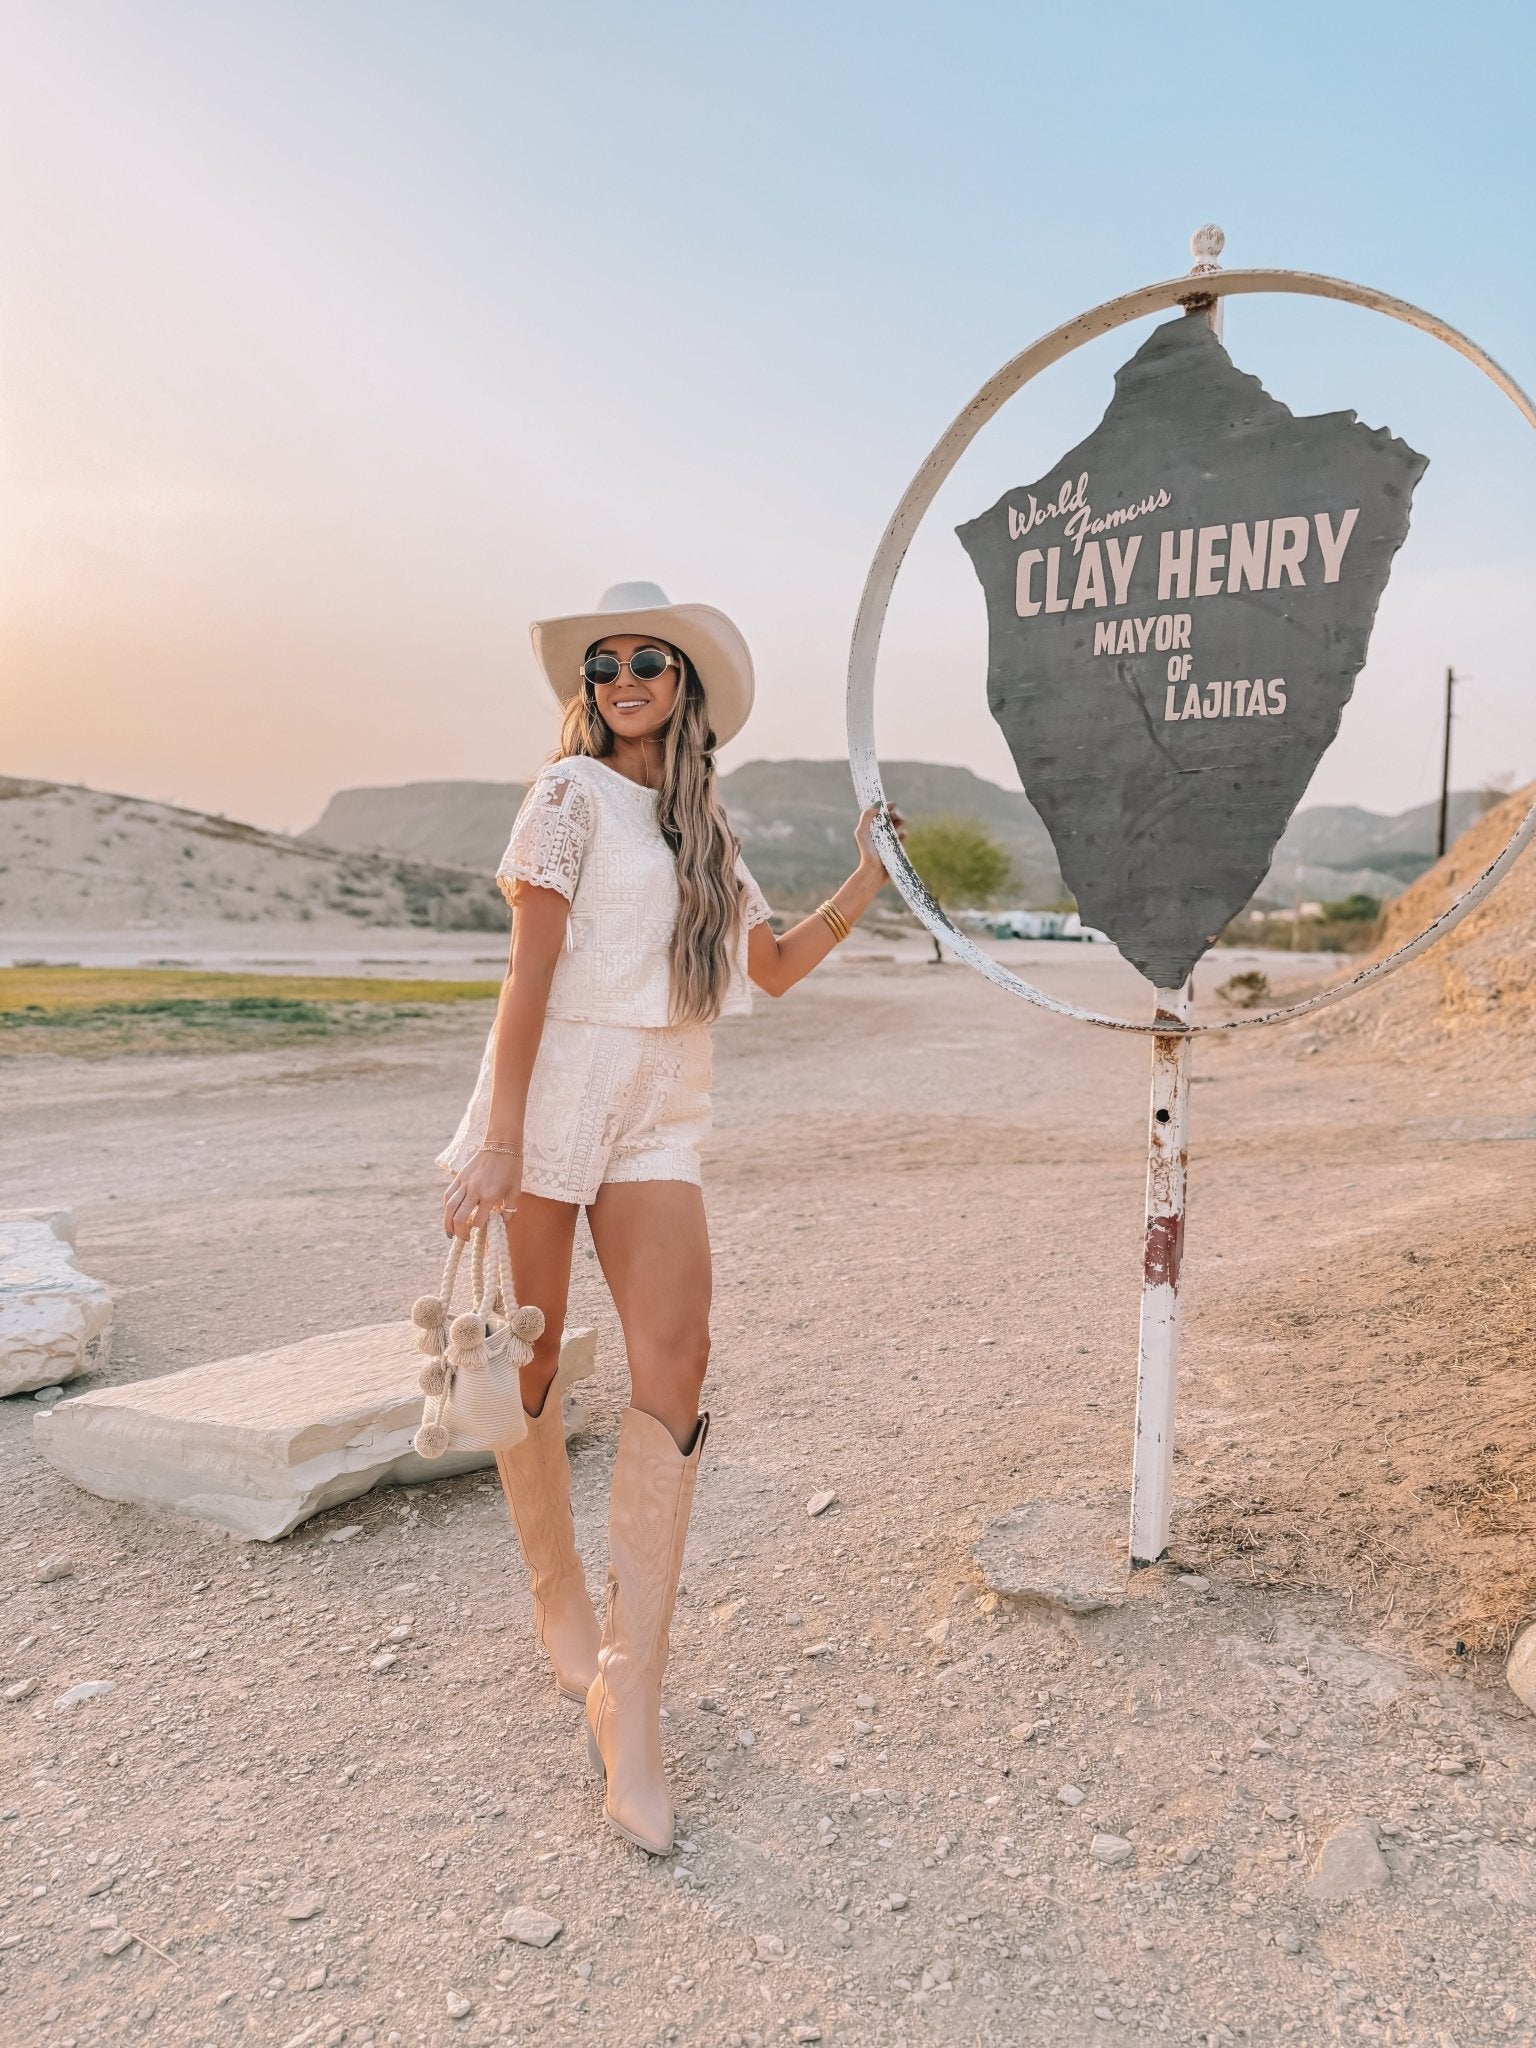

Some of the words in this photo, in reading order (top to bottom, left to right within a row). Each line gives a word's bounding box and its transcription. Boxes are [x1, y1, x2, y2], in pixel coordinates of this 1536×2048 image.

[1008, 471, 1089, 541] World
[1064, 488, 1172, 555] Famous
[1016, 535, 1142, 617] CLAY
[1157, 508, 1360, 600] HENRY
[1093, 613, 1192, 656] MAYOR
[1167, 654, 1193, 682] OF
[1164, 678, 1287, 721] LAJITAS
